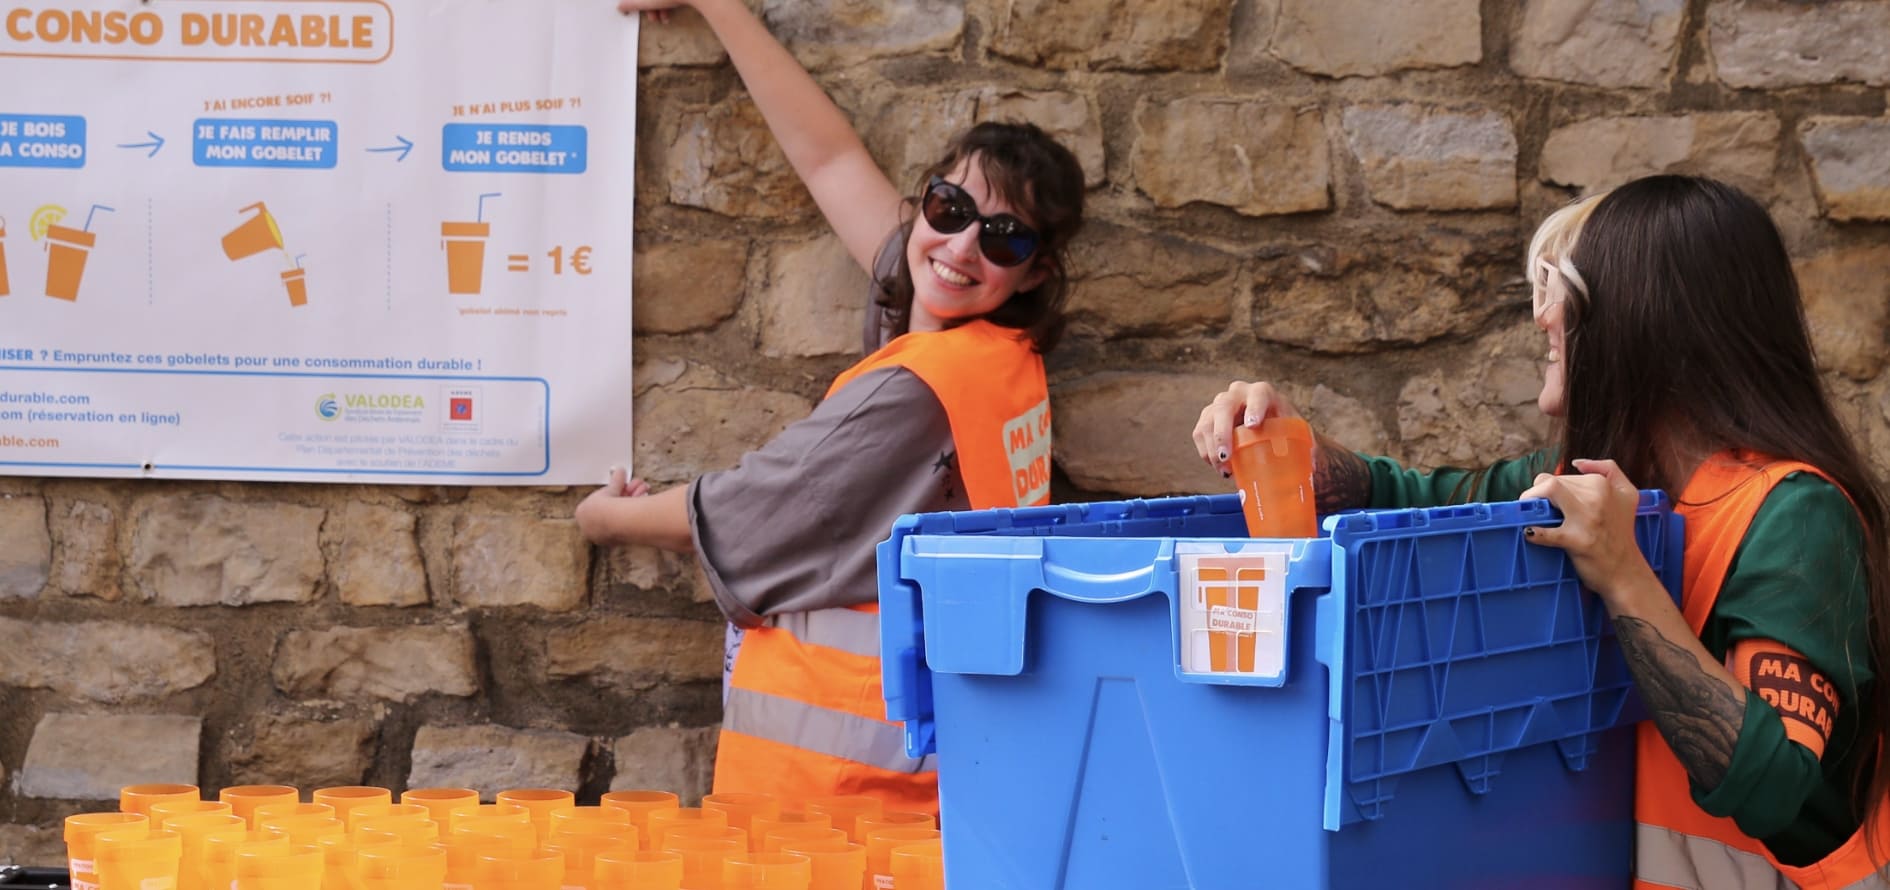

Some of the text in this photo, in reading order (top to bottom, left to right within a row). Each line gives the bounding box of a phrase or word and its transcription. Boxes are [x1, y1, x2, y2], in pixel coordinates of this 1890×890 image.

[5, 8, 374, 48] CONSO DURABLE
[204, 100, 226, 112] J'AI
[231, 96, 282, 110] ENCORE
[286, 93, 314, 106] SOIF
[453, 105, 464, 117] JE
[470, 103, 496, 115] N'AI
[501, 101, 531, 113] PLUS
[536, 98, 564, 111] SOIF
[0, 121, 66, 138] JE BOIS
[198, 125, 331, 142] JE FAIS REMPLIR
[476, 131, 552, 146] JE RENDS
[18, 142, 83, 159] CONSO
[206, 145, 323, 161] MON GOBELET
[450, 150, 567, 166] MON GOBELET
[547, 244, 593, 276] 1€
[40, 350, 48, 361] ?
[54, 350, 131, 365] Empruntez
[137, 354, 162, 364] ces
[167, 352, 230, 367] gobelets
[235, 355, 267, 368] pour
[273, 356, 300, 367] une
[304, 357, 413, 370] consommation
[417, 358, 472, 370] durable
[344, 394, 424, 409] VALODEA
[27, 409, 114, 425] (réservation
[119, 412, 136, 424] en
[141, 412, 181, 426] ligne)
[1010, 420, 1034, 455] MA
[1016, 455, 1050, 498] DUR
[1758, 659, 1801, 682] MA
